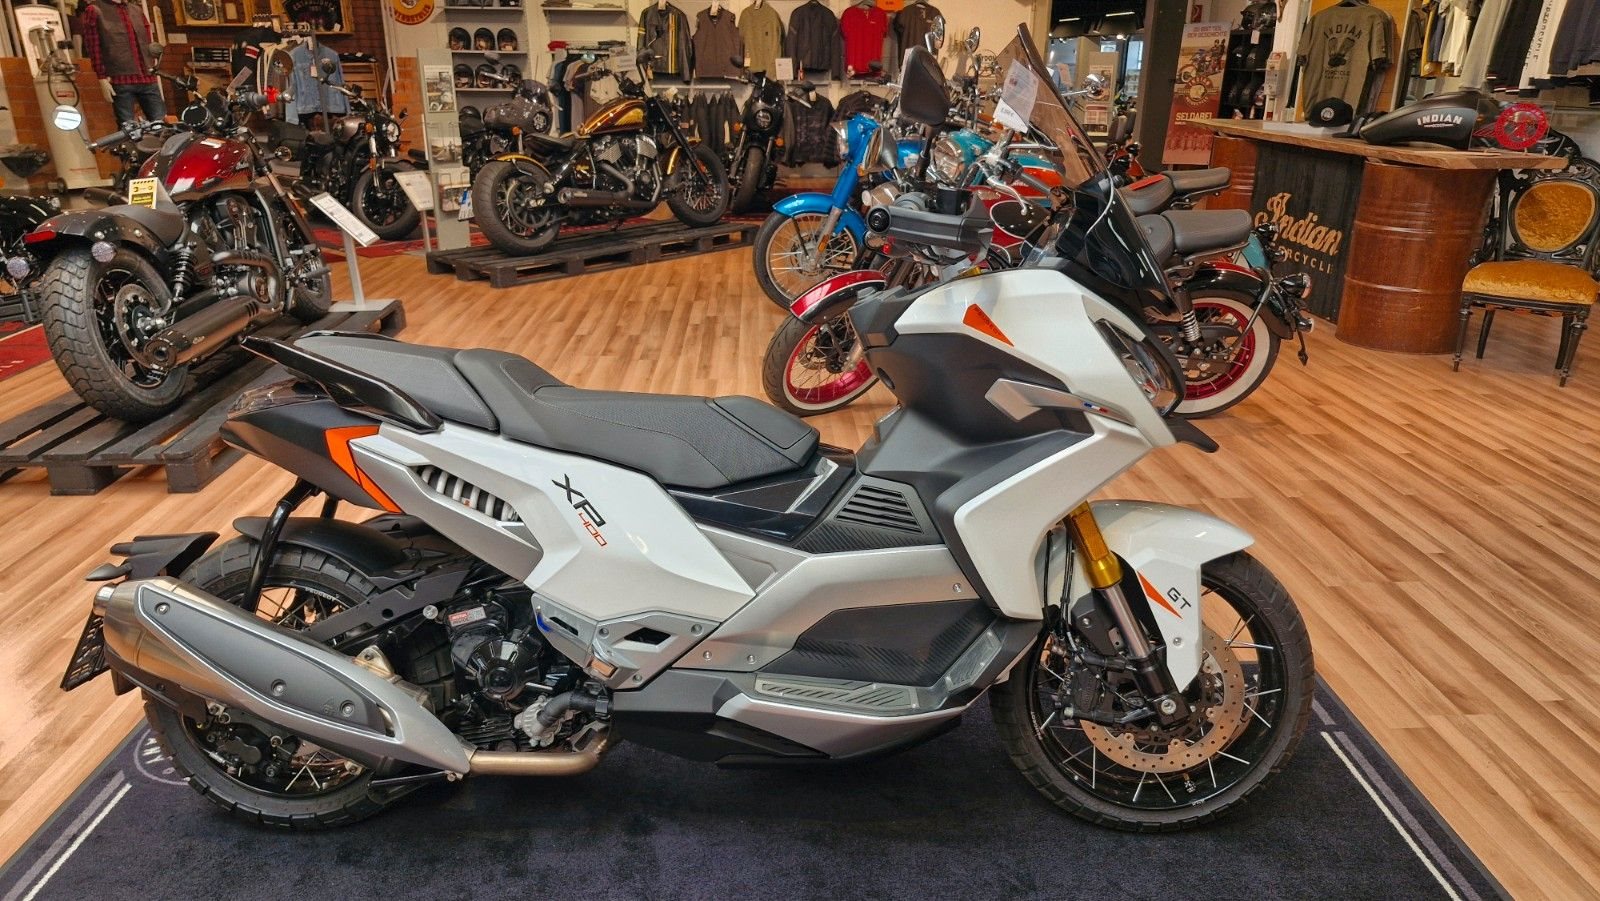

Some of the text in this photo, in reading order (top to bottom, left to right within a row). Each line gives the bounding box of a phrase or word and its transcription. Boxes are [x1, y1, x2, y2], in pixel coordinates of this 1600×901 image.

[1323, 24, 1362, 39] INDIAN
[1416, 113, 1463, 126] INDIAN
[1255, 192, 1342, 256] Indian
[552, 473, 606, 527] XP
[578, 512, 607, 547] 400
[304, 586, 336, 602] PEUGEOT
[1166, 587, 1192, 609] GT
